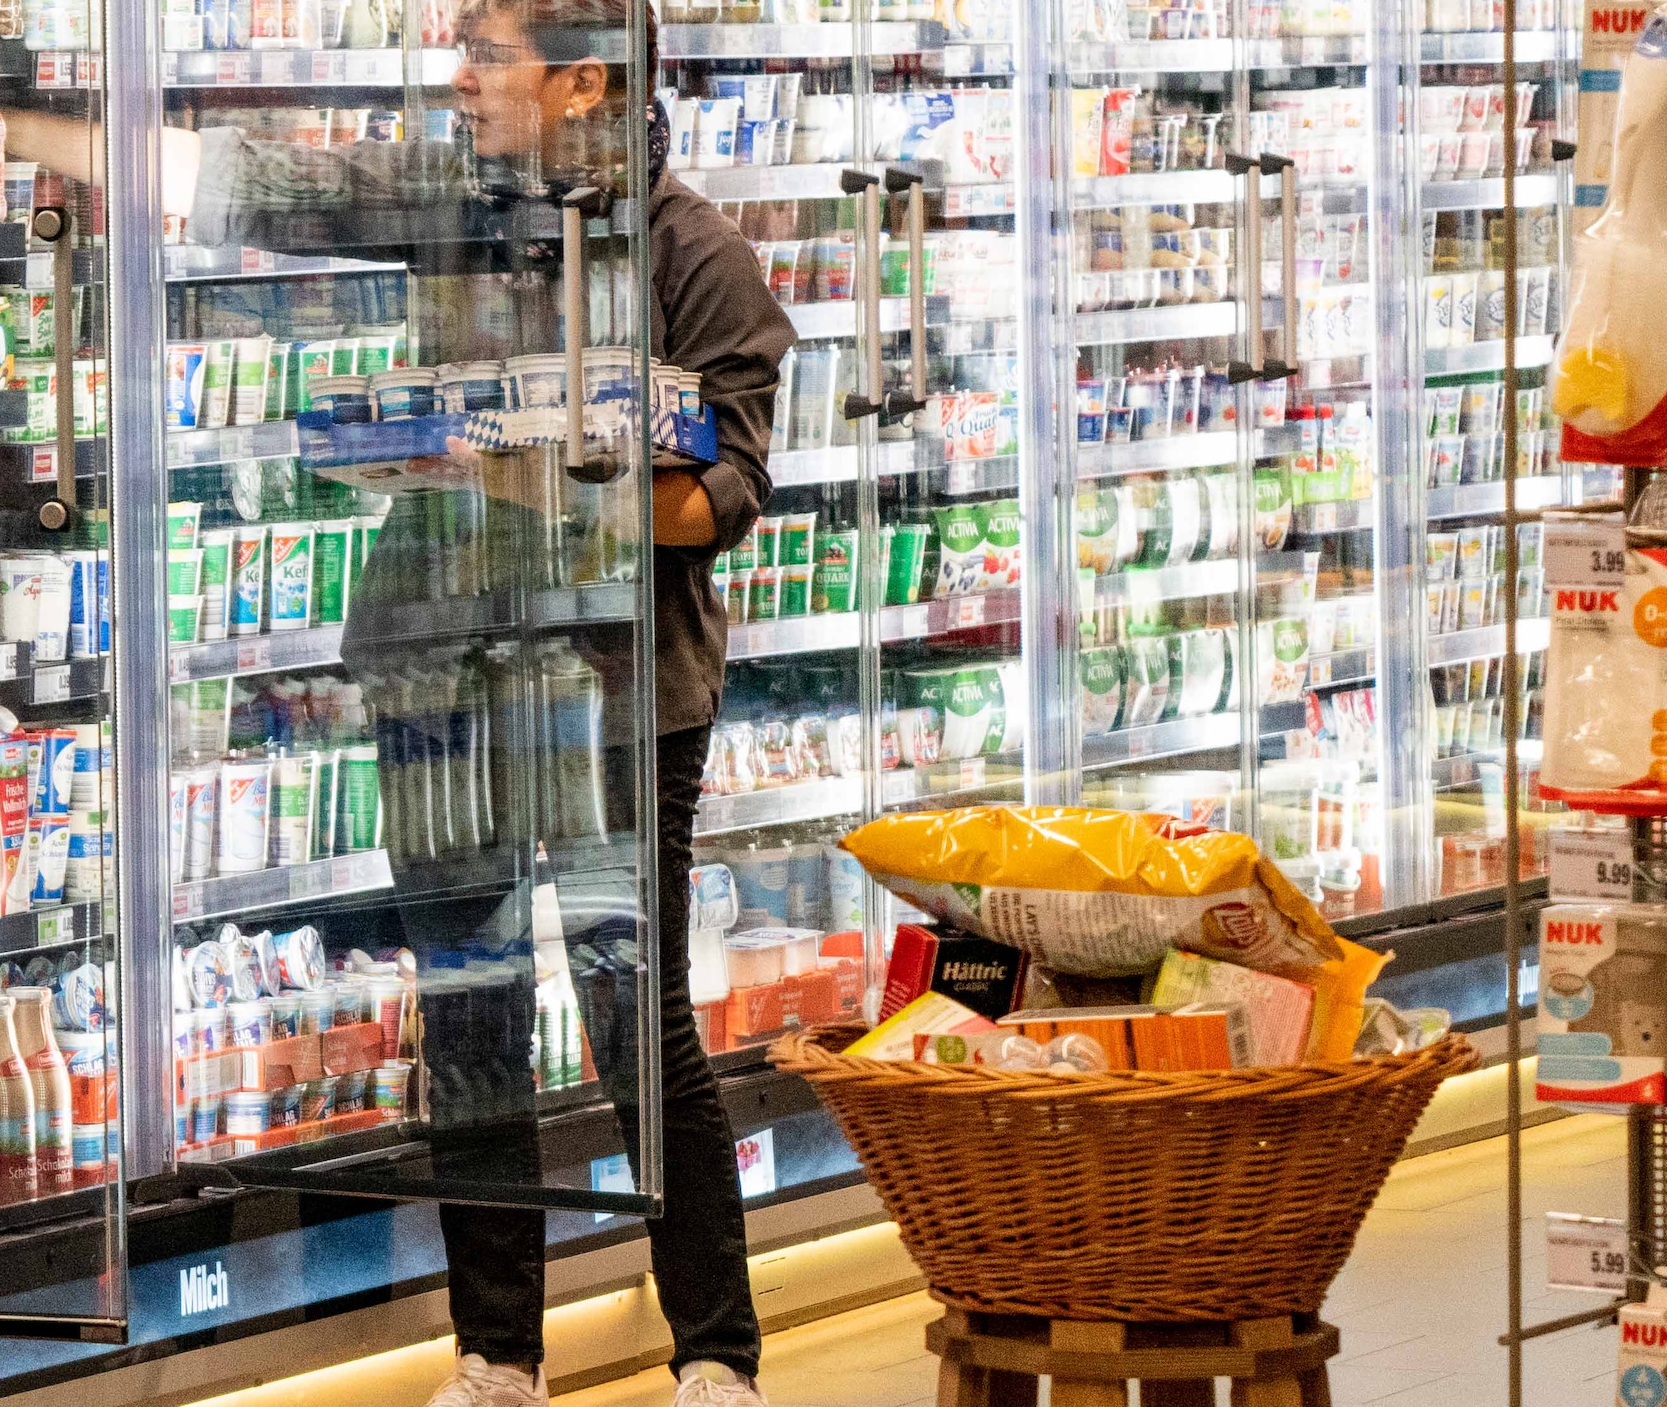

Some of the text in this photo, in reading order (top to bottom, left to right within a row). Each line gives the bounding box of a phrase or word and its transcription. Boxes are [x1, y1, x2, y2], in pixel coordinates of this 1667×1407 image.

[1592, 10, 1647, 34] NUK
[947, 522, 978, 538] ACTIVIA
[1591, 550, 1624, 573] 3.99
[1556, 589, 1620, 612] NUK
[952, 685, 983, 701] ACTIVIA
[6, 785, 24, 796] Frische
[1596, 861, 1631, 885] 9.99
[1546, 923, 1604, 946] NUK
[942, 961, 1007, 980] Hättric
[1591, 1249, 1625, 1274] 5.99
[180, 1261, 228, 1316] Milch
